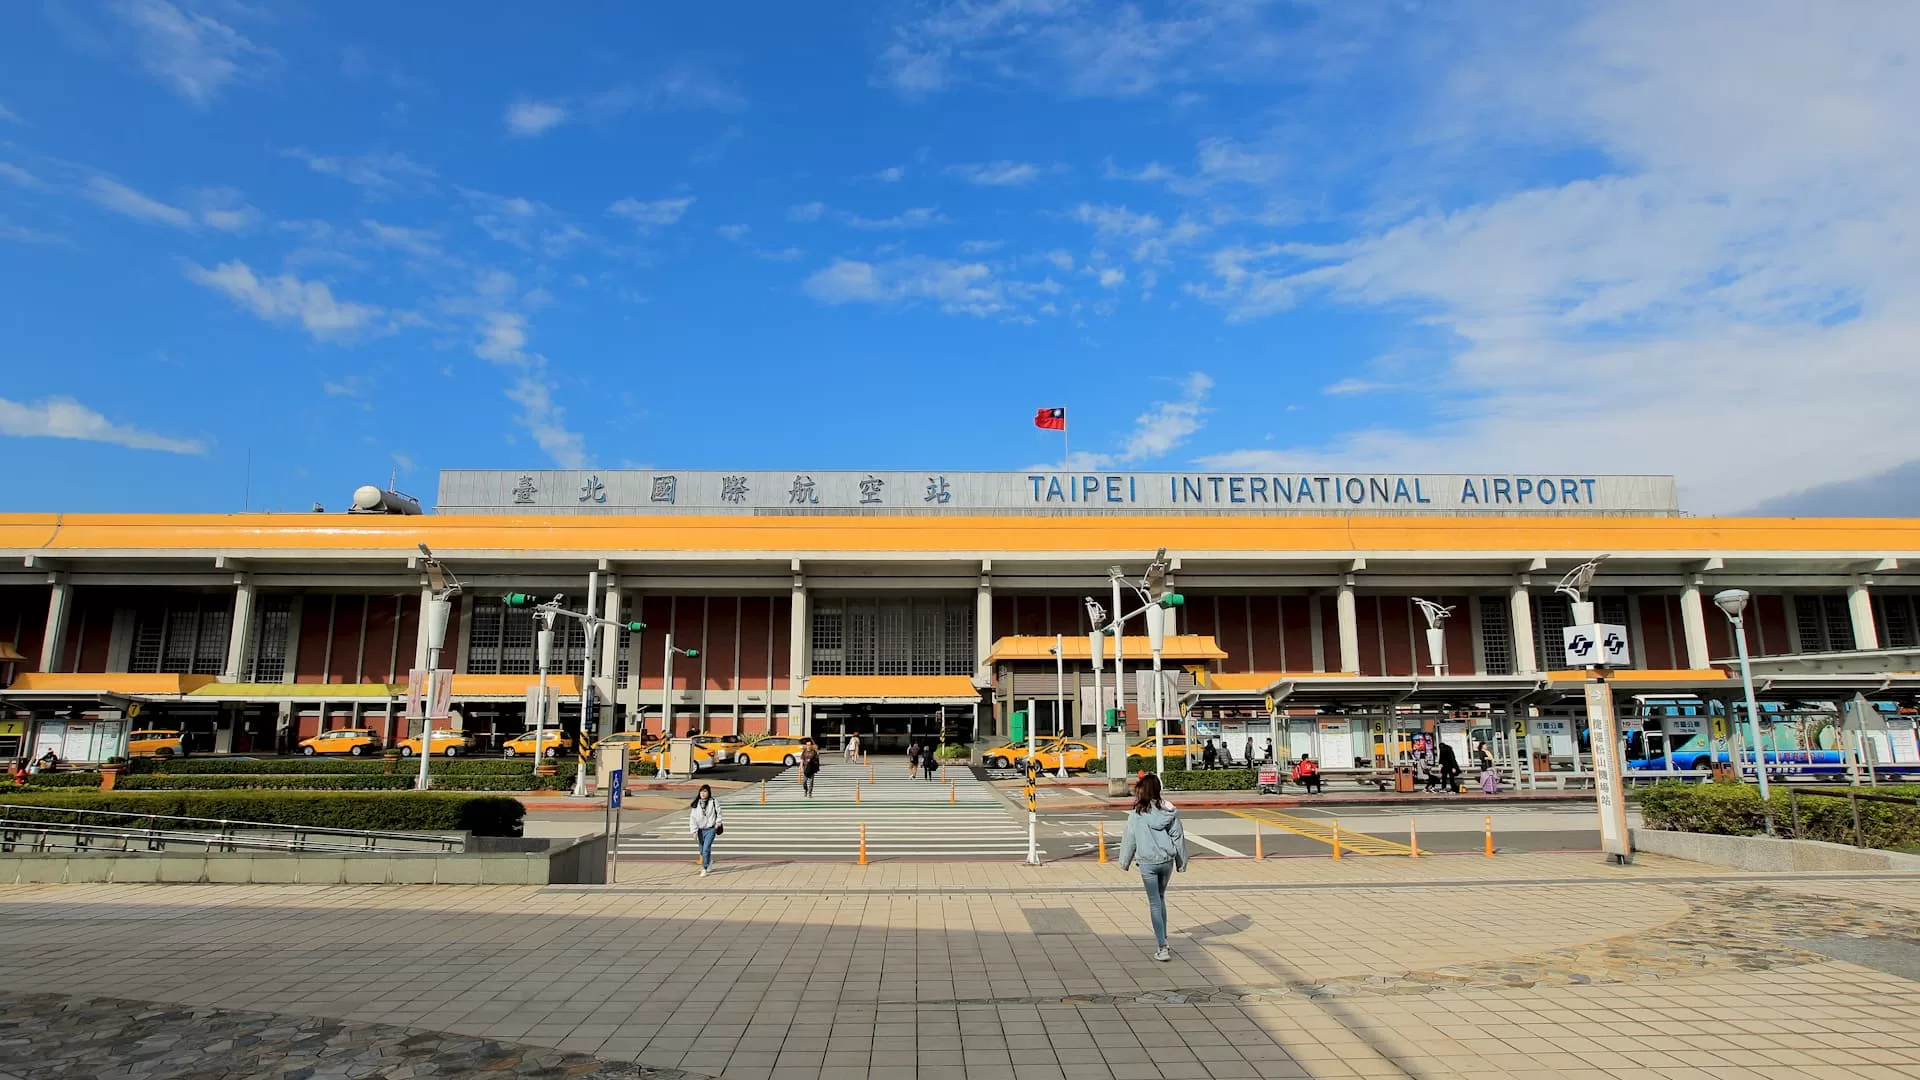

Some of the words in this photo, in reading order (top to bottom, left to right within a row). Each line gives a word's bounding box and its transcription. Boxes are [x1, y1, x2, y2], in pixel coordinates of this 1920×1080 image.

[512, 475, 952, 505] 臺北國際航空站
[1028, 475, 1136, 503] TAIPEI
[1171, 476, 1431, 504] INTERNATIONAL
[1460, 477, 1596, 505] AIRPORT
[1189, 670, 1197, 686] 1
[131, 704, 138, 715] 7
[7, 723, 15, 734] 7
[1375, 722, 1382, 732] 6
[1514, 721, 1522, 733] 2
[1715, 720, 1722, 732] 1
